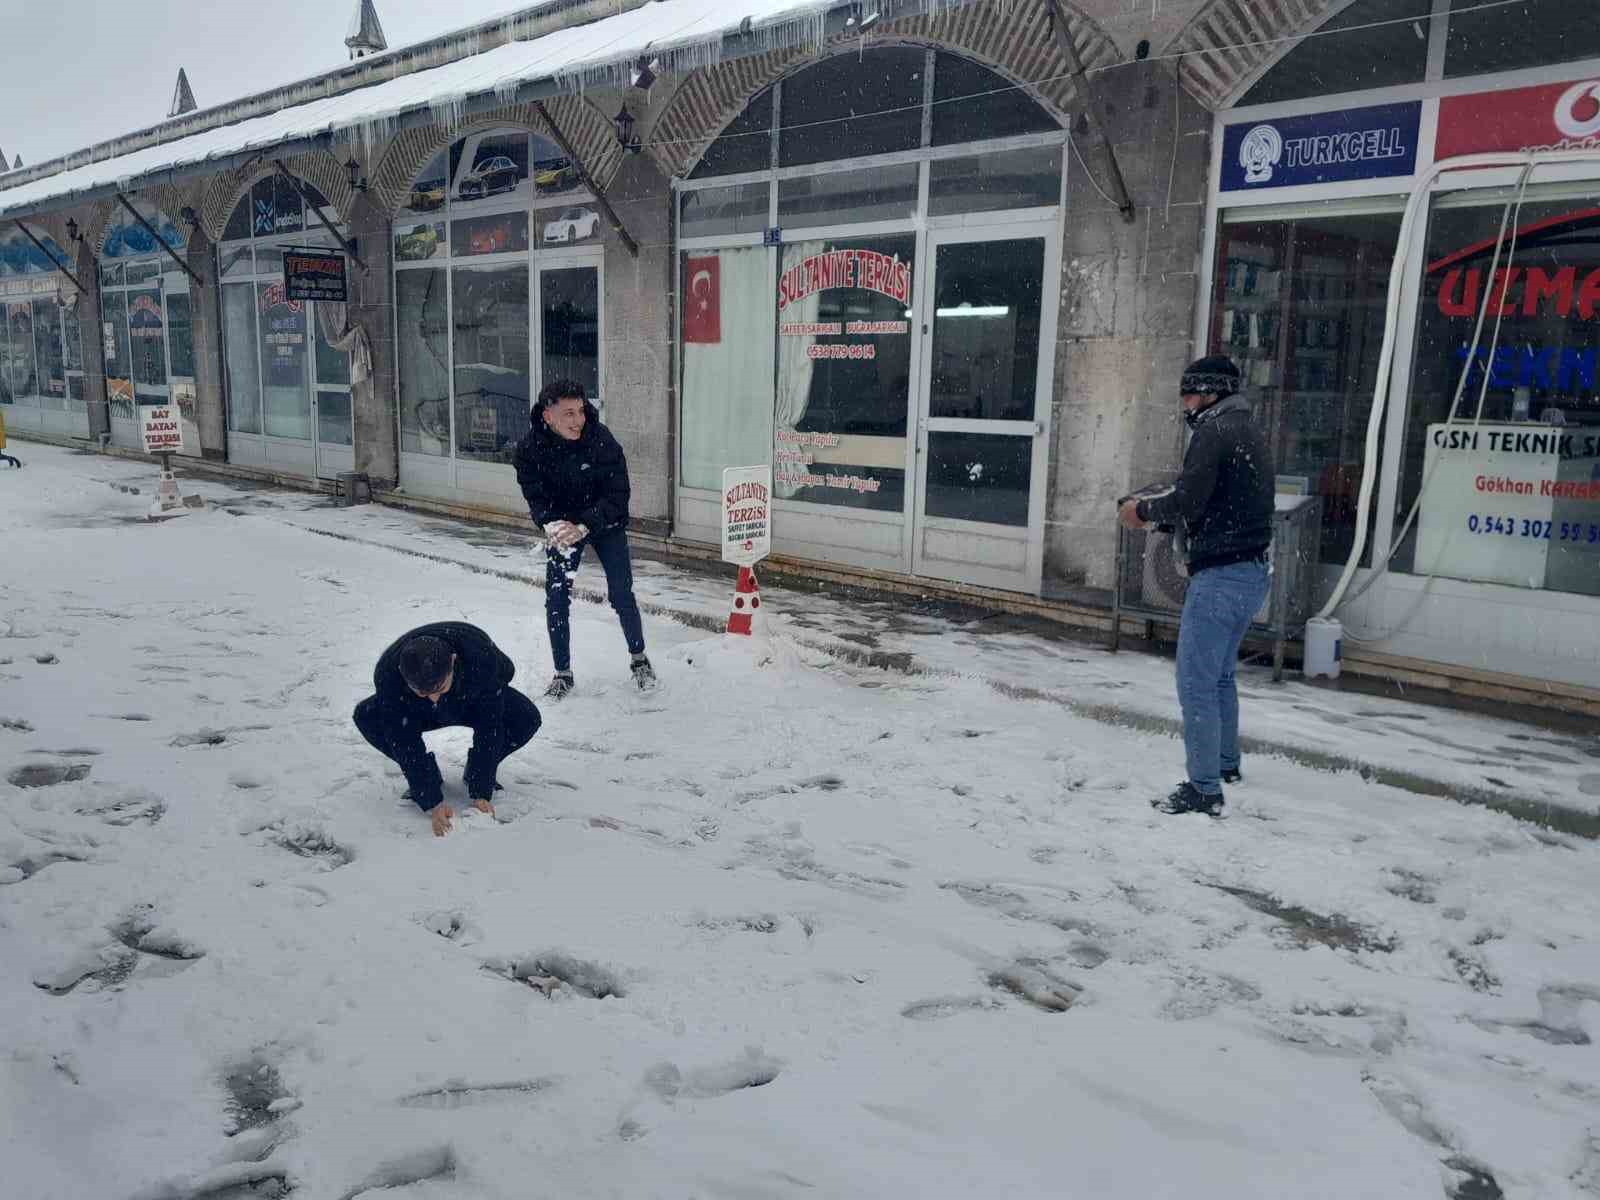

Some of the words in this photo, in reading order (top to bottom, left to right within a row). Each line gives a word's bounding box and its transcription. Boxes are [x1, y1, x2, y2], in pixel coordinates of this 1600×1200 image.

[1285, 127, 1405, 168] TURKCELL
[779, 246, 854, 312] SULTANİYE
[855, 249, 911, 306] TERZİSİ
[152, 410, 168, 419] BAY
[1488, 429, 1574, 457] TEKNİK
[726, 480, 768, 511] SULTANİYE
[1475, 475, 1533, 495] Gökhan
[1468, 514, 1515, 536] 0,543
[1520, 519, 1552, 539] 302
